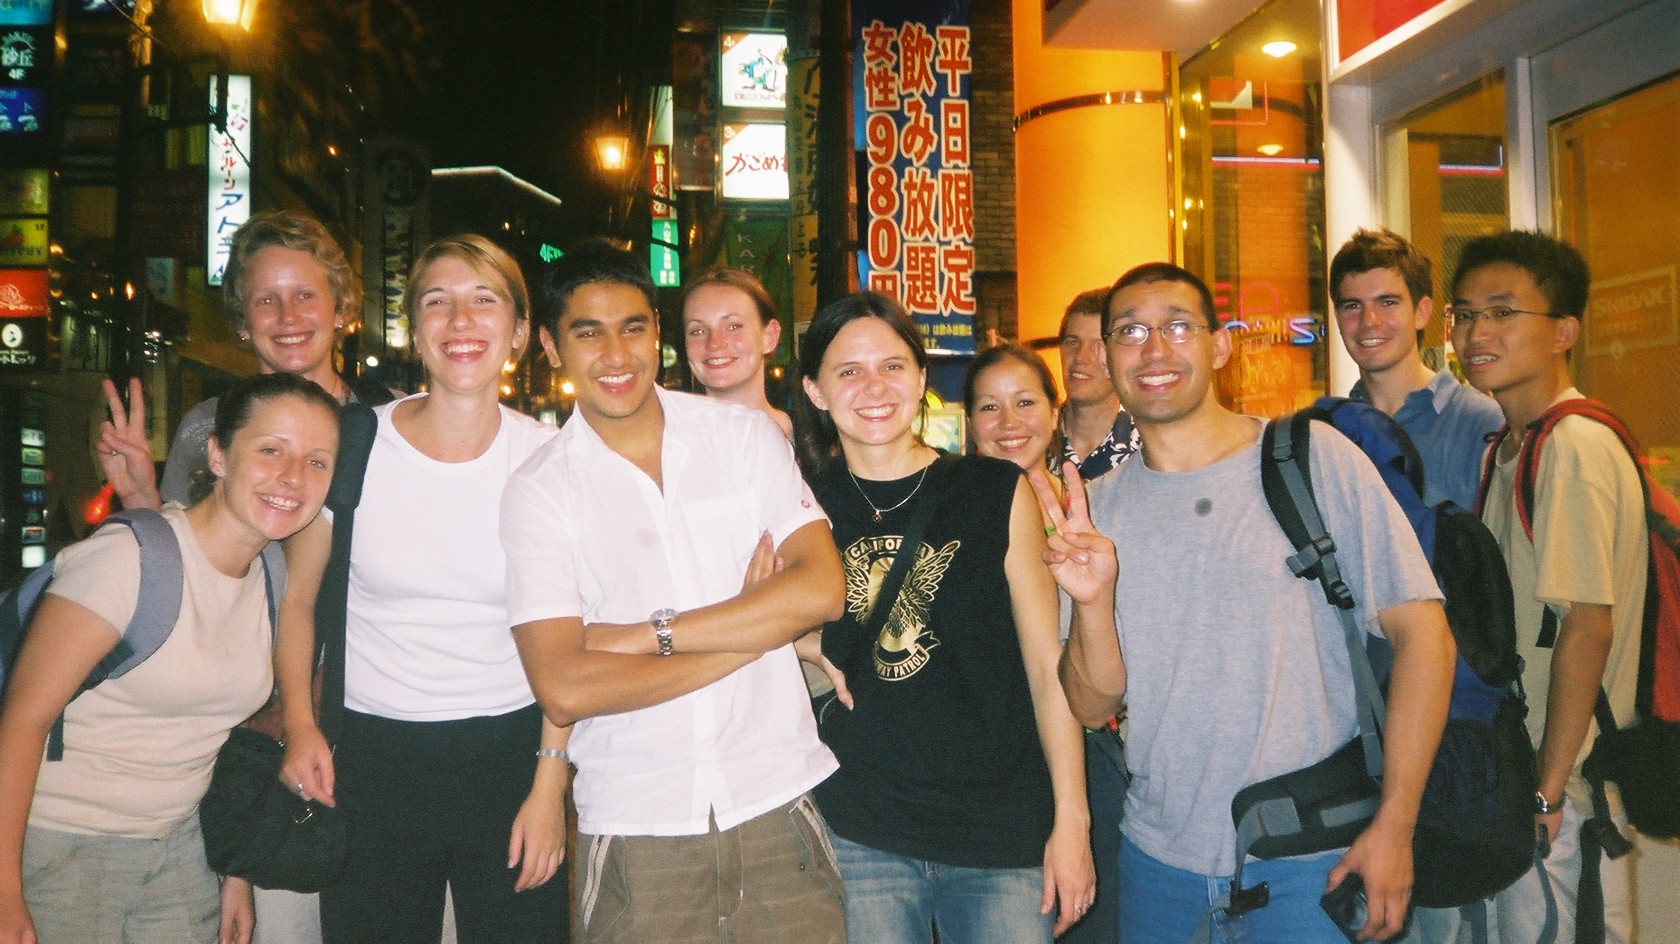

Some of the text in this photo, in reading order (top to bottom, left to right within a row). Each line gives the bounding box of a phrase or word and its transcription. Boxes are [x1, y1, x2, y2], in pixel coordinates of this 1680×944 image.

[899, 21, 939, 315] 飲み放題
[935, 26, 977, 317] 平日限定
[893, 653, 926, 678] PATROL
